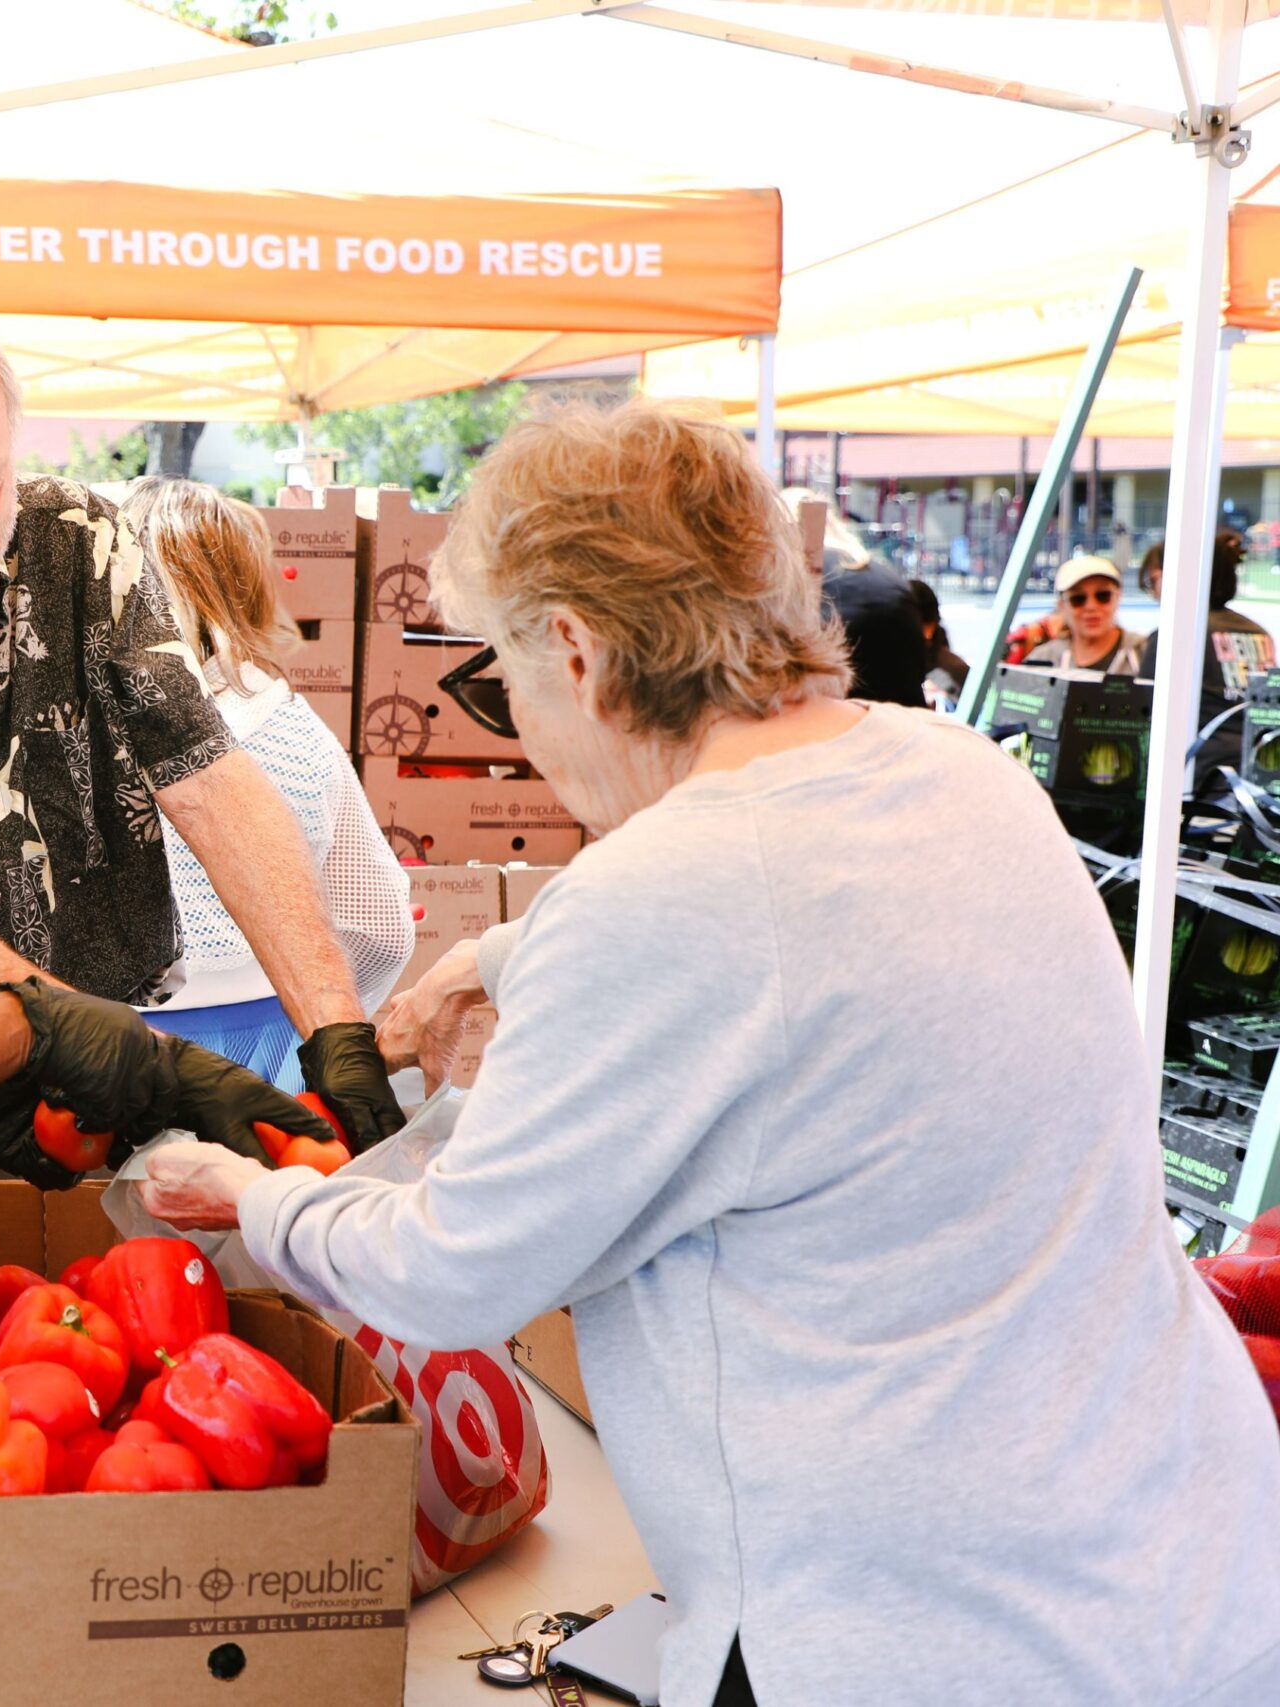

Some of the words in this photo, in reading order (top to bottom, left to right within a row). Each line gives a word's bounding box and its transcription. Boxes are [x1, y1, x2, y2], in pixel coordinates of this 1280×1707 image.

[79, 227, 320, 272] THROUGH
[336, 237, 464, 275] FOOD
[479, 241, 662, 277] RESCUE
[296, 531, 346, 546] republic
[290, 664, 342, 680] republic
[471, 802, 503, 817] fresh
[439, 878, 484, 893] republic
[90, 1566, 182, 1602] fresh
[247, 1559, 383, 1603] republic
[291, 1597, 350, 1610] Greenhouse
[351, 1597, 383, 1610] grown
[188, 1619, 249, 1634] SWEET
[257, 1617, 298, 1631] BELL
[307, 1613, 383, 1629] PEPPERS
